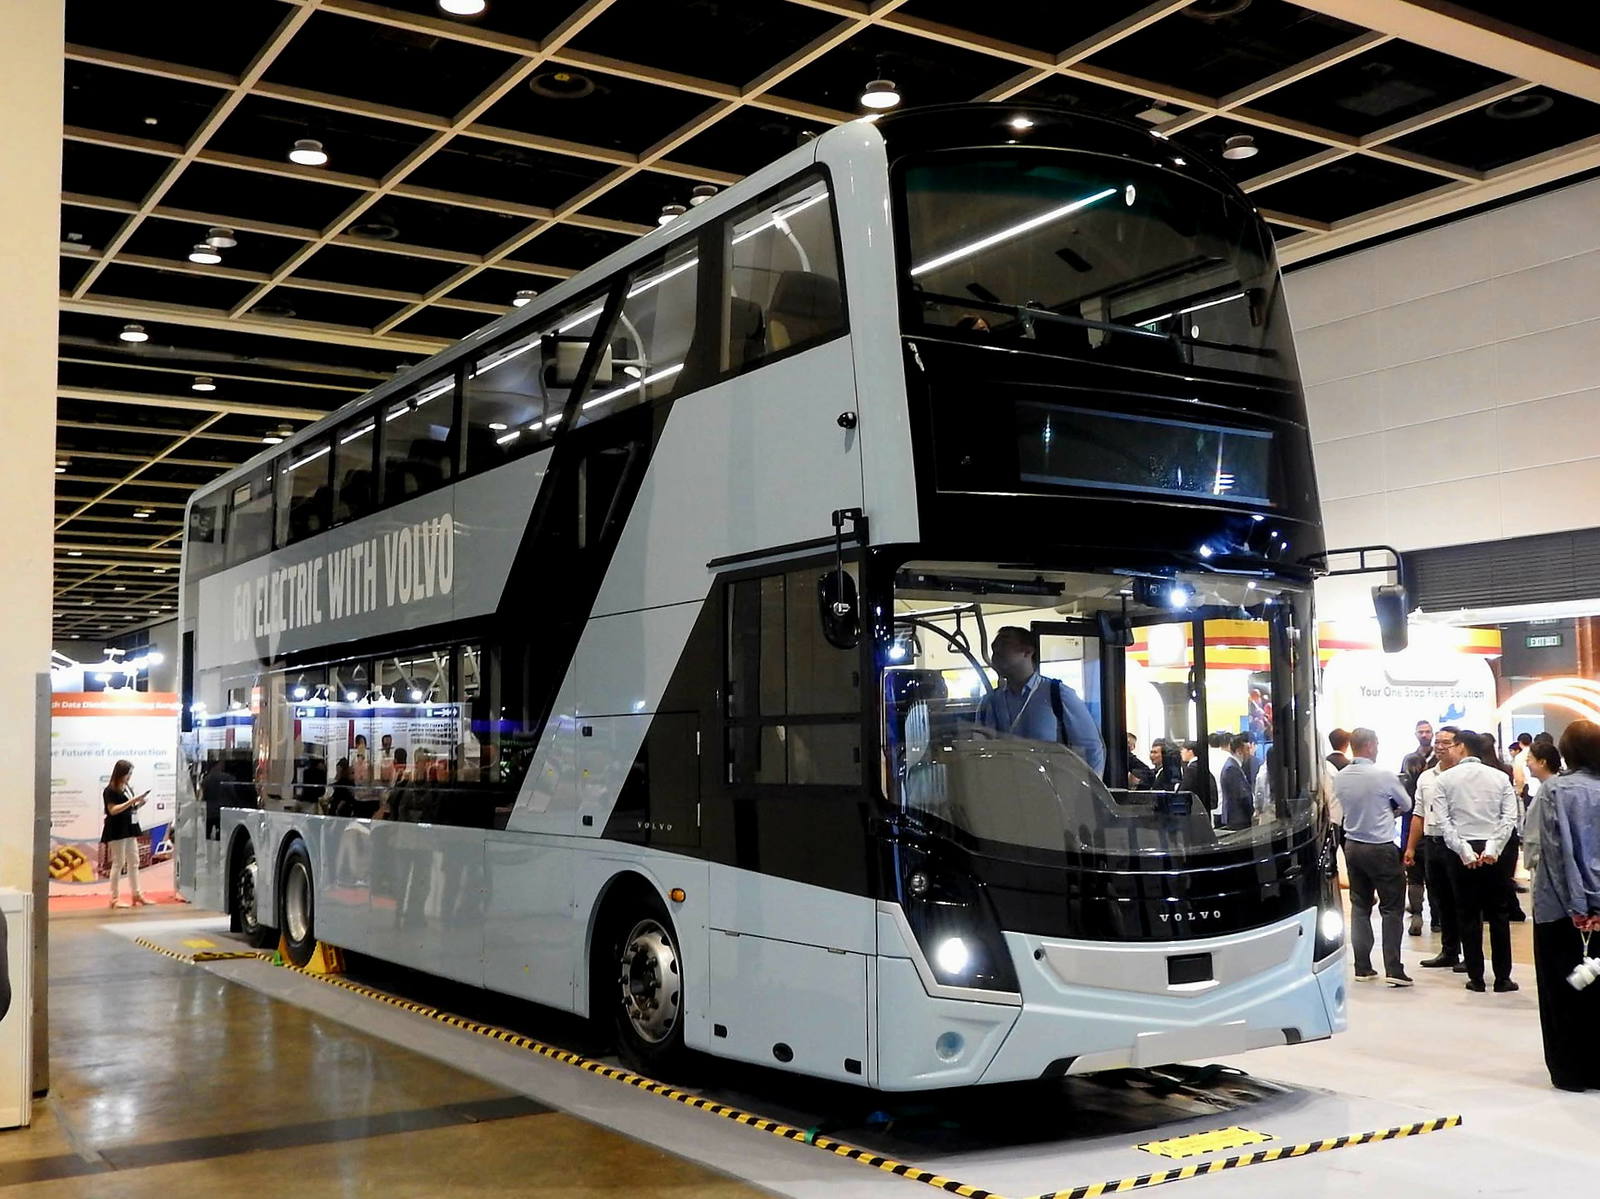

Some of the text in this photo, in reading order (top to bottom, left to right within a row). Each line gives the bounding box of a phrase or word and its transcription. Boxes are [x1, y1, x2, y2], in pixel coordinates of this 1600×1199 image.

[255, 556, 323, 638] ELECTRIC
[327, 538, 377, 620] WITH
[384, 512, 454, 607] VOLVO
[1360, 686, 1381, 697] Your
[1384, 686, 1401, 698] One
[1450, 688, 1485, 698] Solution
[62, 748, 92, 757] Future
[107, 748, 167, 757] Construction
[637, 821, 673, 831] VOLVO
[1160, 910, 1221, 922] VOLVO
